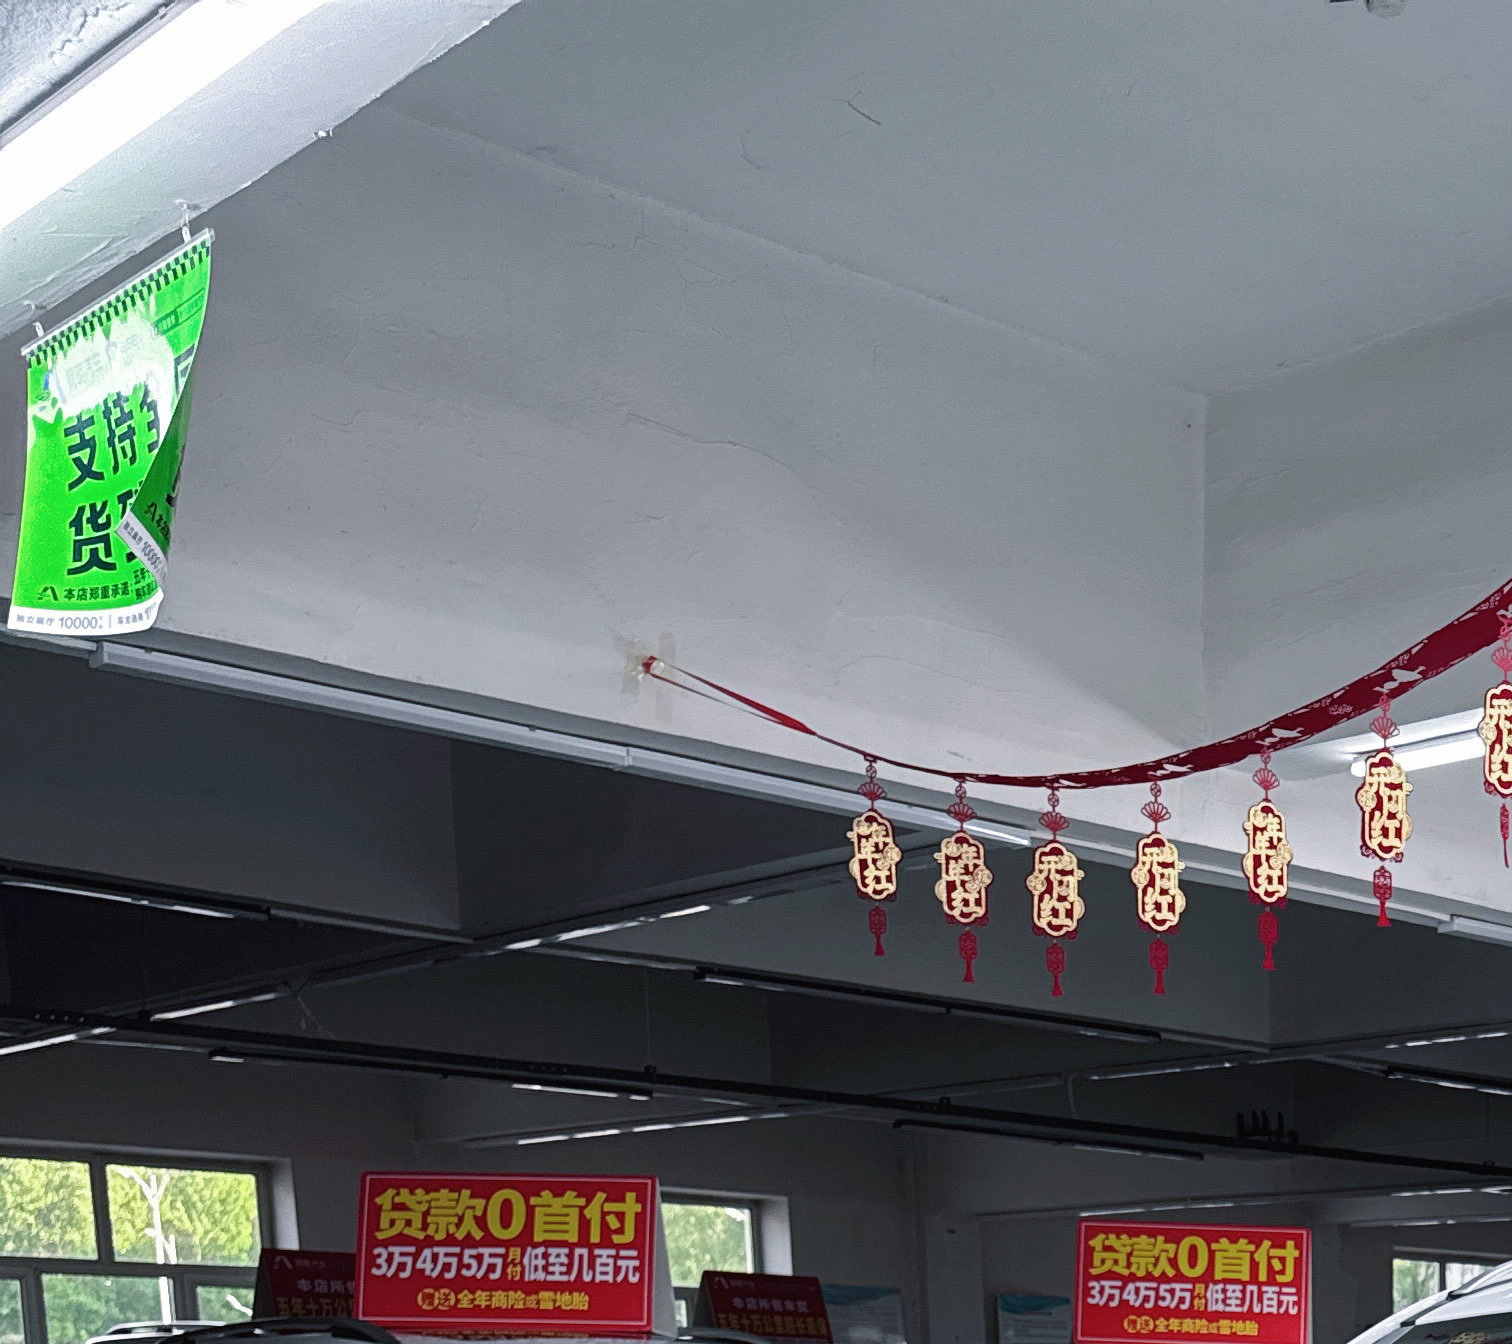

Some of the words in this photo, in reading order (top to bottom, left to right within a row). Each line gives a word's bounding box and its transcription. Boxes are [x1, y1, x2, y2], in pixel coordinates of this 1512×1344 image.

[374, 1187, 642, 1244] 贷款0首付
[1088, 1233, 1299, 1283] 贷款0首付
